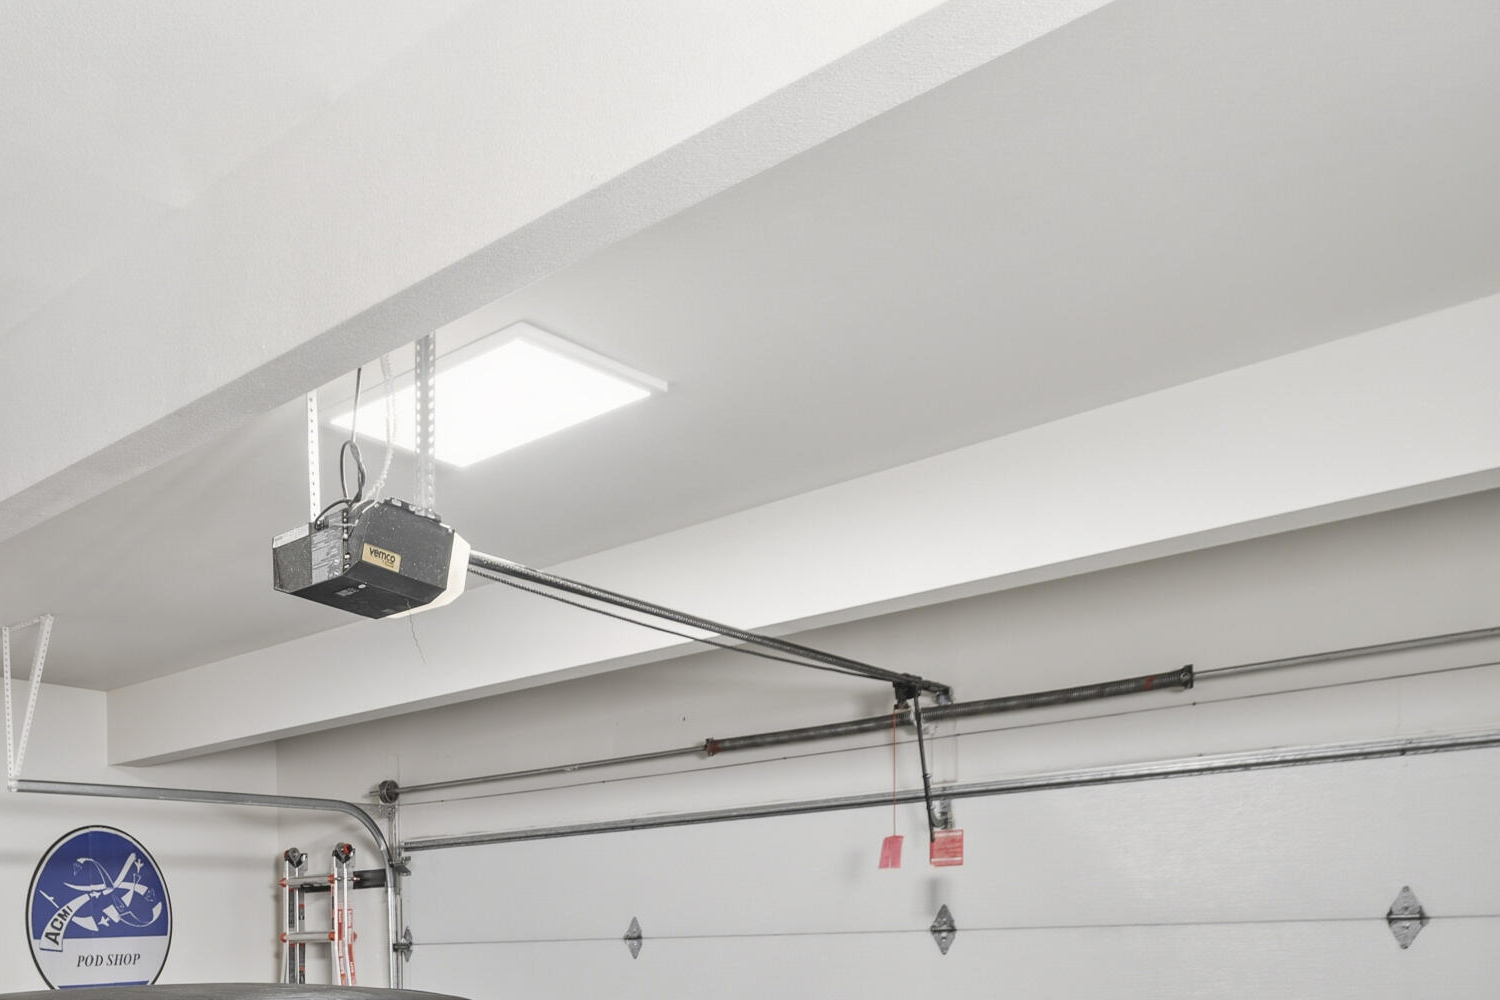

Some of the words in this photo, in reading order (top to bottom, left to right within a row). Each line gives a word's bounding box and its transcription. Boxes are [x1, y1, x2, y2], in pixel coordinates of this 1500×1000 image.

[44, 905, 74, 946] ACMI
[76, 954, 104, 967] POD
[106, 953, 141, 967] SHOP
